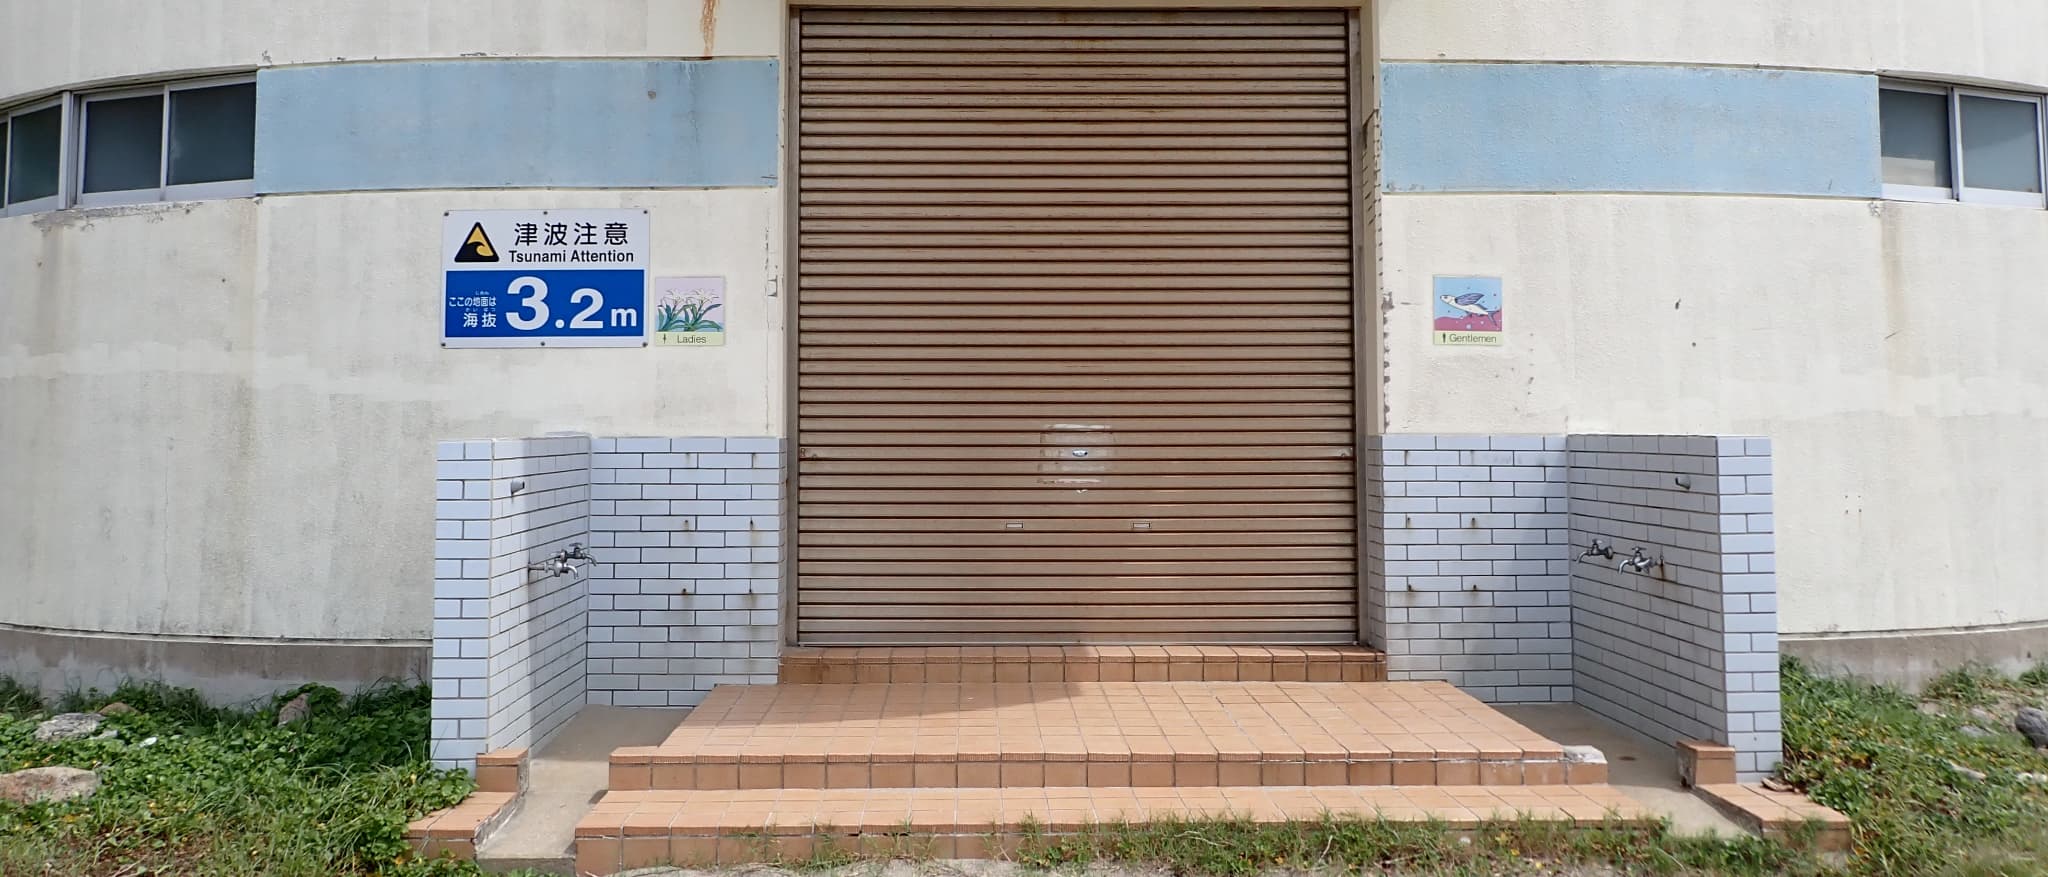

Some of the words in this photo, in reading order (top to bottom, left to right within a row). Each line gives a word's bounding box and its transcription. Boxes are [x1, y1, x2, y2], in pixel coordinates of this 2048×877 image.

[514, 222, 629, 247] 津波注意
[508, 250, 566, 263] Tsunami
[570, 249, 634, 263] Attention
[448, 296, 497, 307] ここの地面は
[463, 312, 497, 328] 海抜
[677, 334, 707, 344] Ladies
[1448, 333, 1497, 344] Gentlemen
